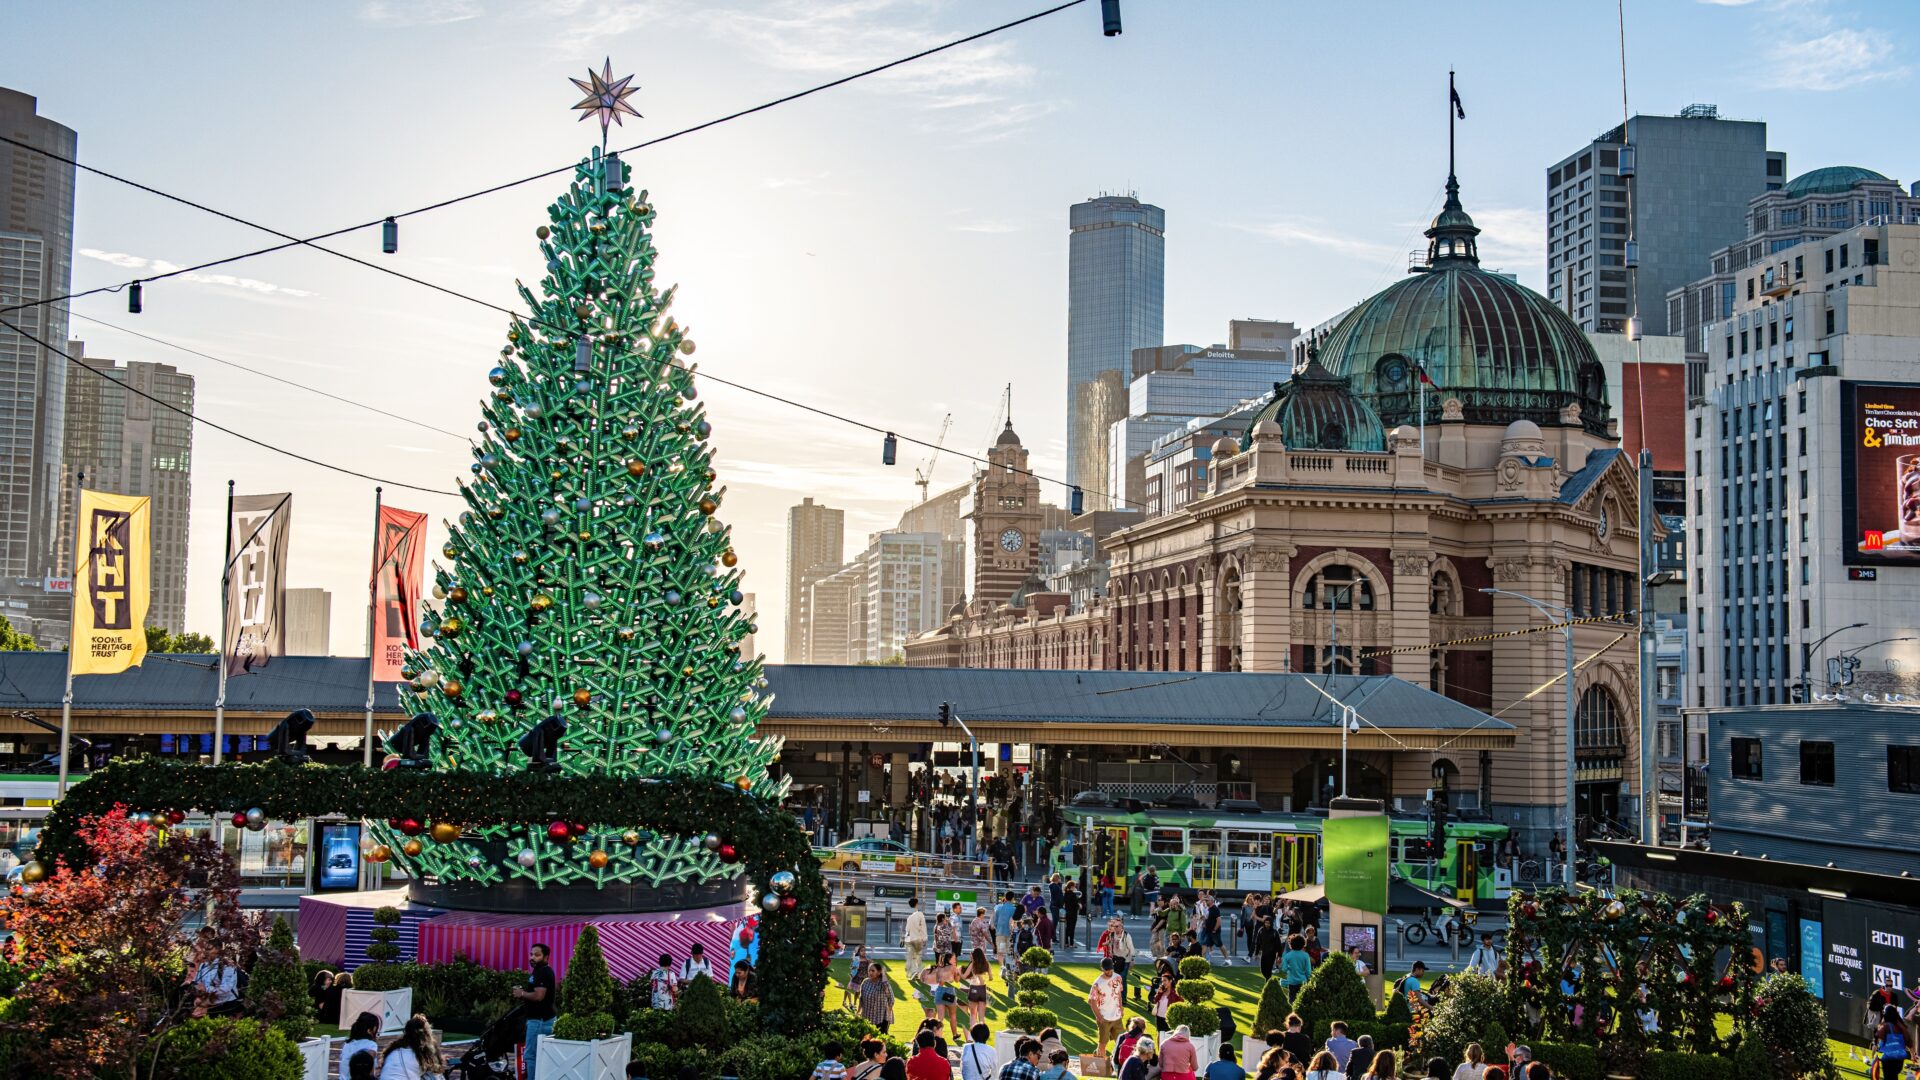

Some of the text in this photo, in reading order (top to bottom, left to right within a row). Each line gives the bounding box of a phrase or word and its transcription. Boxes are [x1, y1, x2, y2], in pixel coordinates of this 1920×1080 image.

[1865, 417, 1918, 428] Choc Soft
[1864, 427, 1882, 448] &
[97, 514, 125, 625] KHT
[91, 636, 123, 644] KOONE
[91, 643, 132, 651] HERITAGE
[91, 650, 118, 658] TRUST
[386, 644, 404, 652] KOO
[1871, 930, 1904, 949] acmi
[1832, 943, 1858, 958] WHAT'S ON
[1828, 953, 1835, 963] AT
[1834, 955, 1844, 965] FED
[1843, 957, 1863, 970] SQUARE
[1875, 967, 1900, 987] KHT
